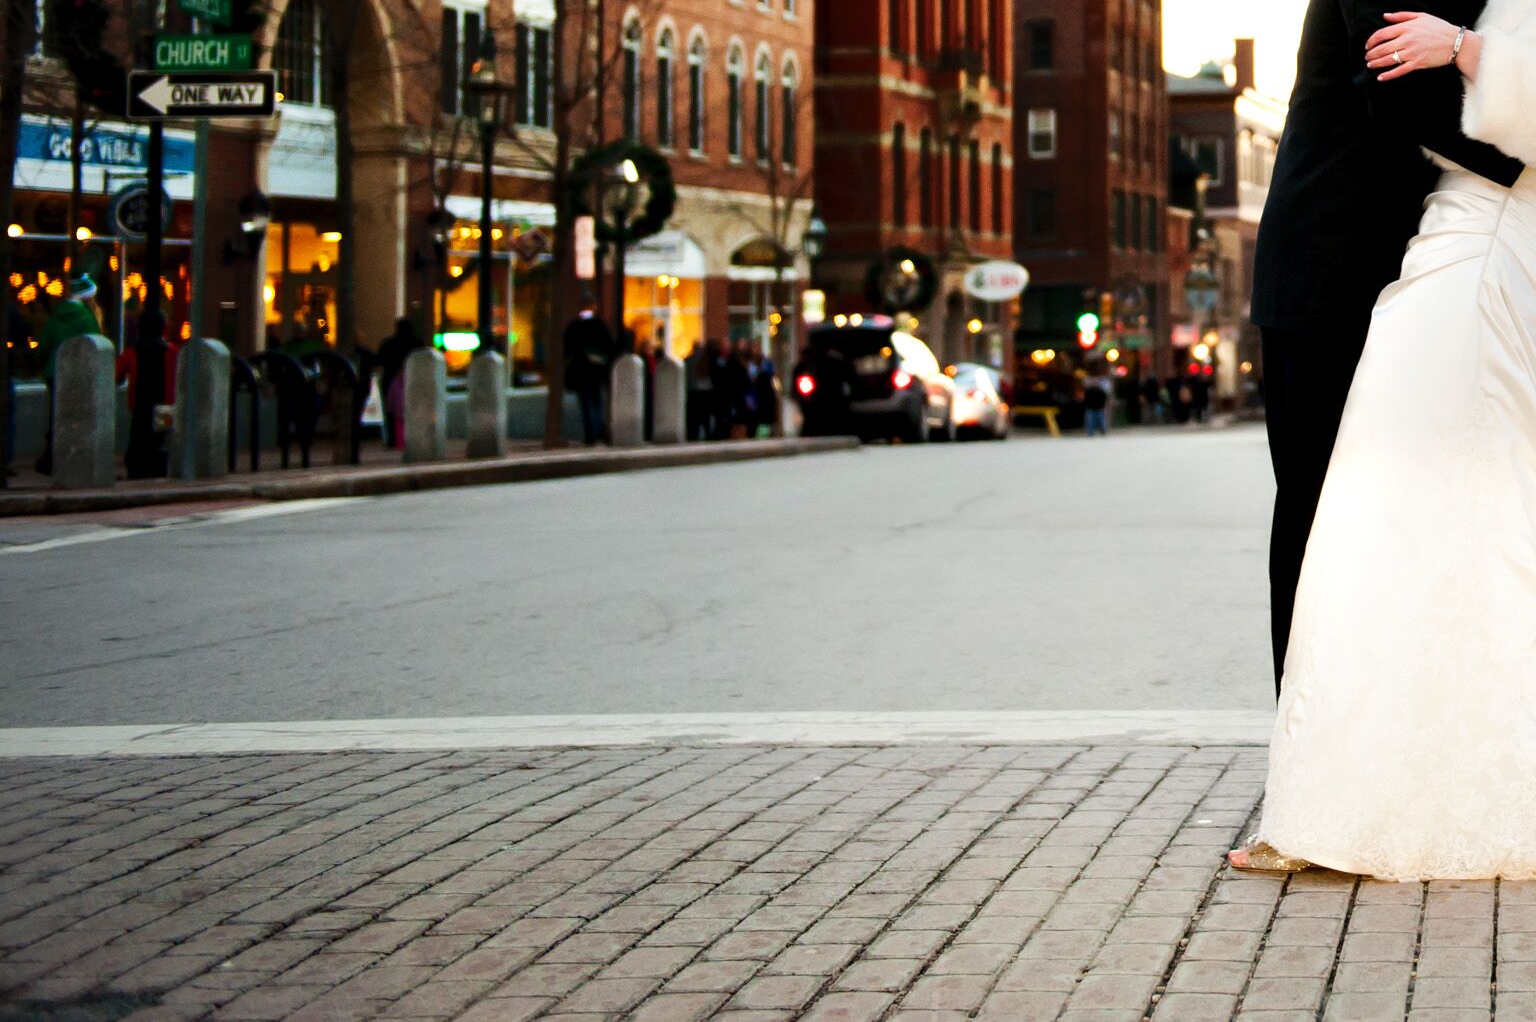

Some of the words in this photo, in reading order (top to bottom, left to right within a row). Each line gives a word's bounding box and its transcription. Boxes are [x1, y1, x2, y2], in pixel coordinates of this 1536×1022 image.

[155, 40, 229, 66] CHURCH
[171, 84, 209, 103] ONE
[217, 84, 257, 102] WAY
